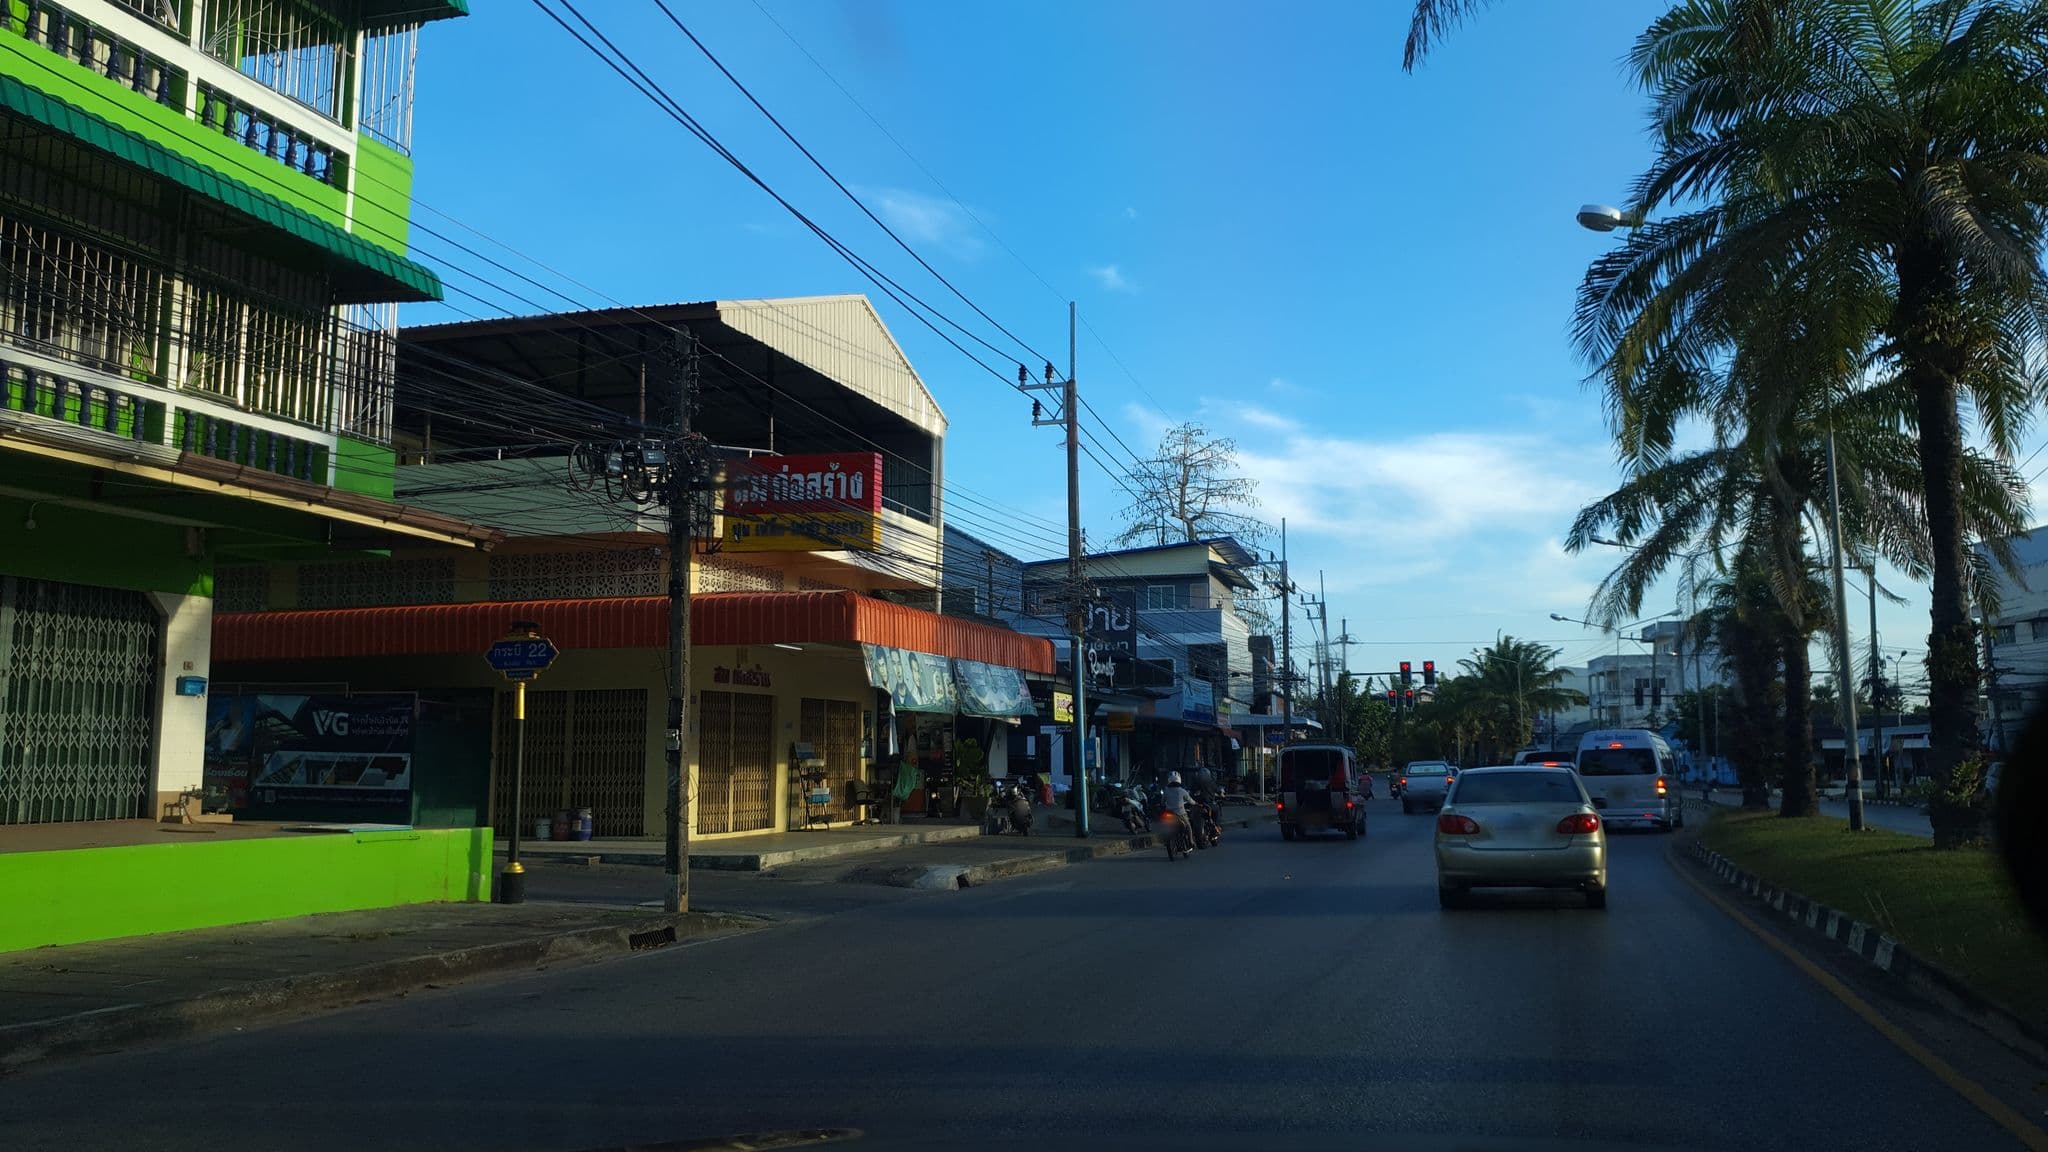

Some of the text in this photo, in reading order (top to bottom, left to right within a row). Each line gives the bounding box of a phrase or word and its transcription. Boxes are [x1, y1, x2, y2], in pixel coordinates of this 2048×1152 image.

[773, 462, 863, 502] ก่อสร้าง
[528, 642, 547, 658] 22
